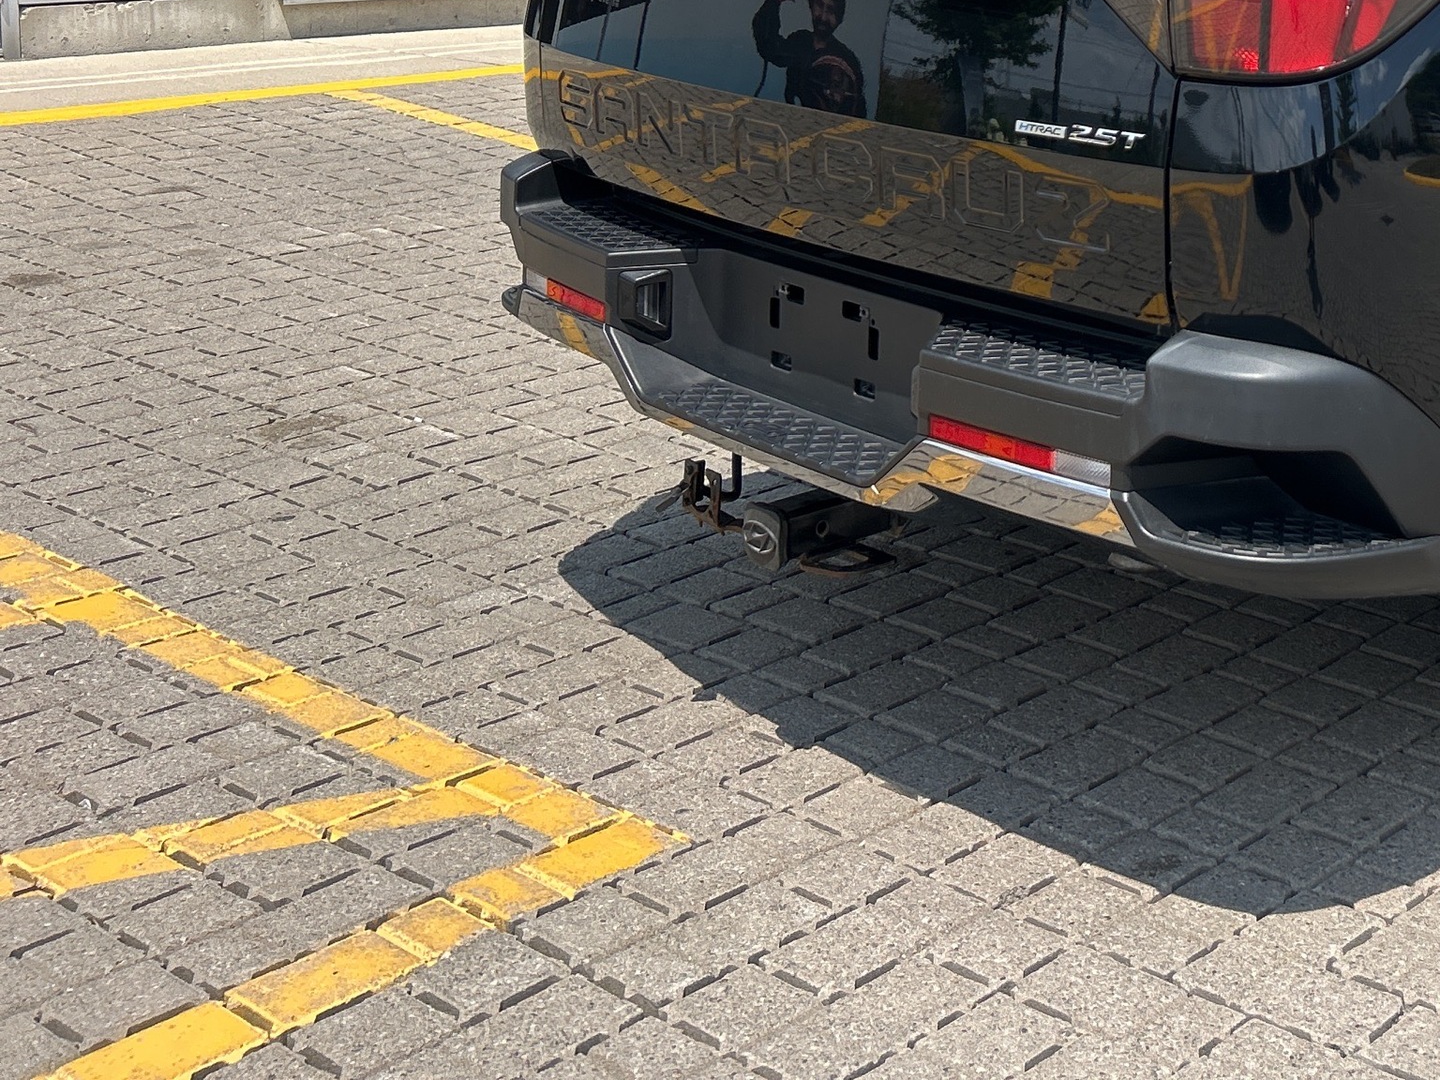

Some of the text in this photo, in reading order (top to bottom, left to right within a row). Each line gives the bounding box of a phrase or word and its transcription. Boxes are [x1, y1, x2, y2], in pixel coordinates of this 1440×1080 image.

[558, 68, 1111, 254] SANTA CRUZ
[1019, 122, 1061, 137] HTRAC
